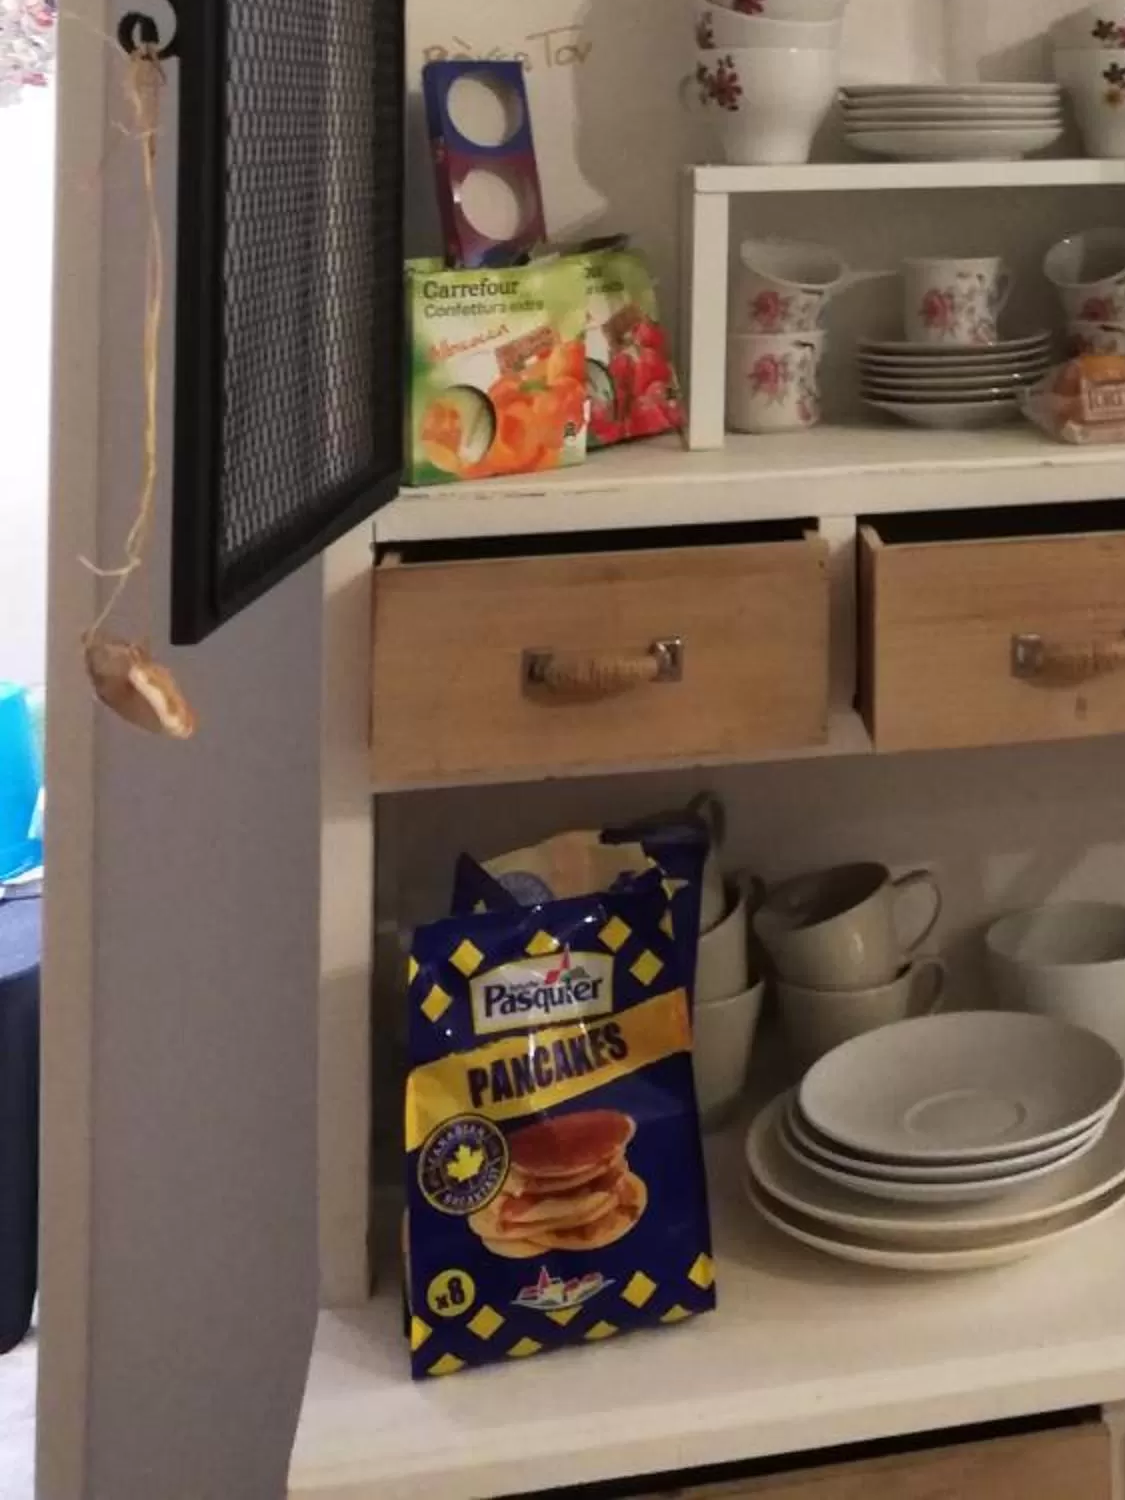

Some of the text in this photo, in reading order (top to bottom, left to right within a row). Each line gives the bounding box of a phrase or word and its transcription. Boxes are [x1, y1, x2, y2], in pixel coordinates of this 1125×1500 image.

[422, 277, 520, 300] Carrefour
[483, 976, 604, 1019] Pasquier
[466, 1022, 629, 1109] PANCAKES
